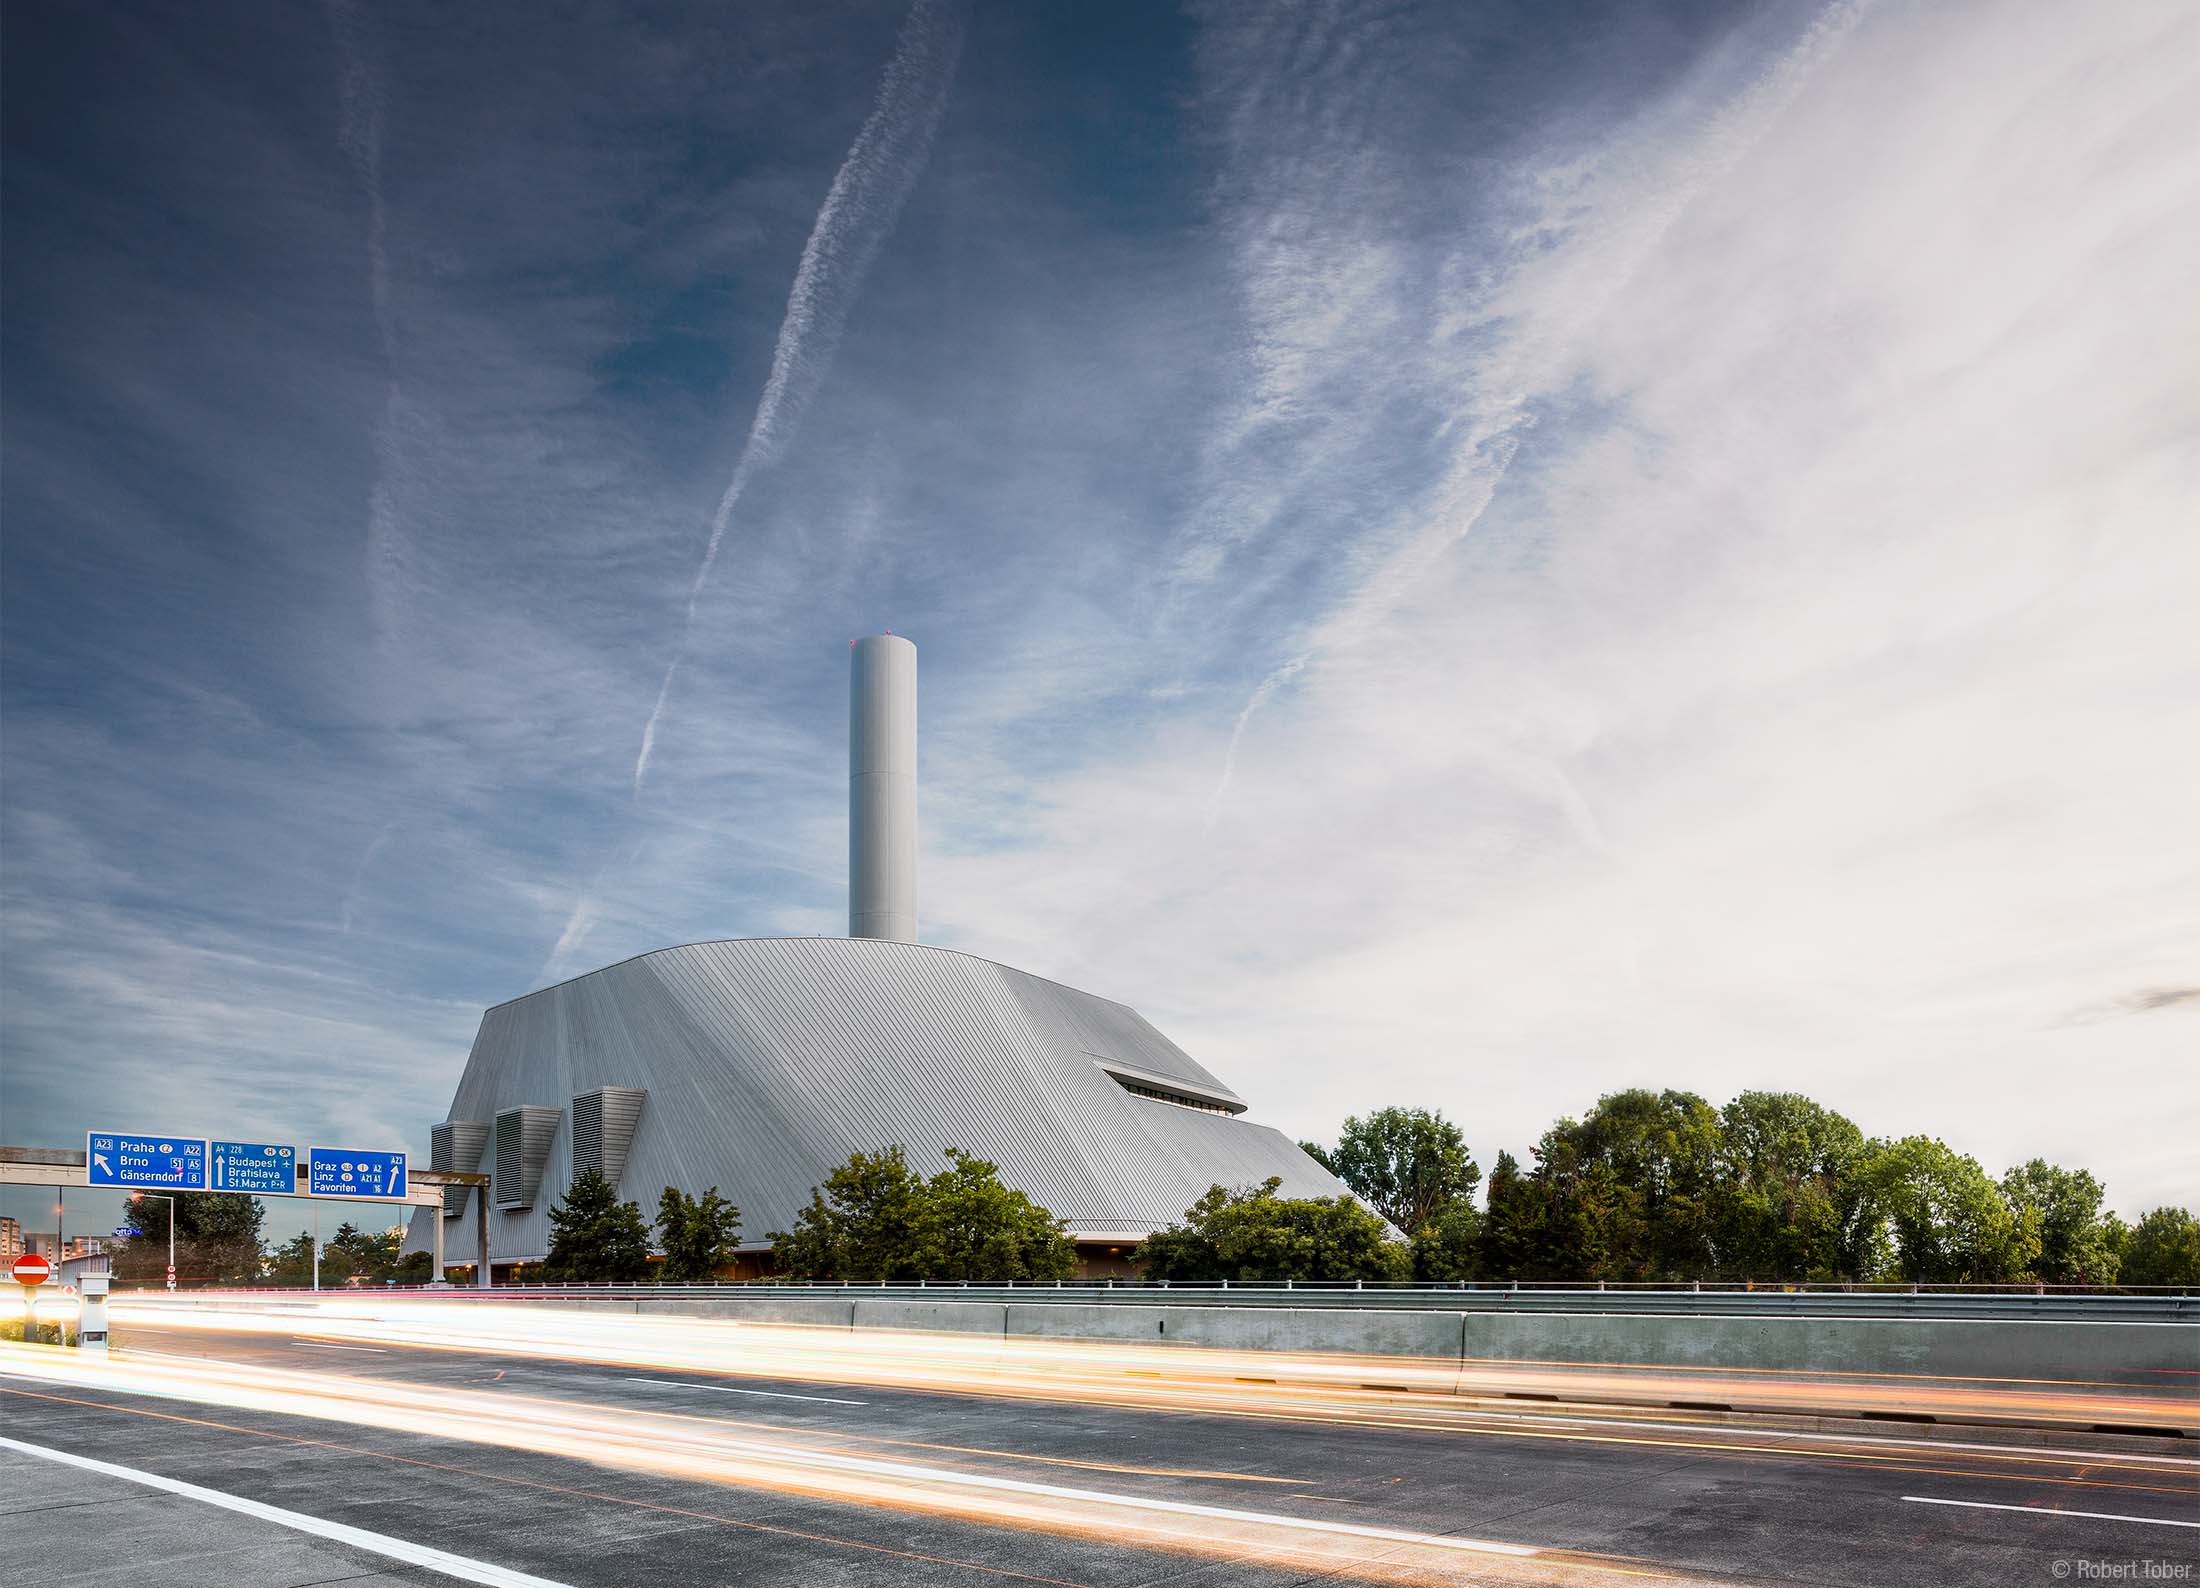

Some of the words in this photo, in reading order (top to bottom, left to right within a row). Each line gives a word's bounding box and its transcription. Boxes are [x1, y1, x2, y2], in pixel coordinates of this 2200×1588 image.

[96, 1140, 112, 1149] A23
[120, 1141, 155, 1153] Praha
[185, 1146, 200, 1155] A22
[120, 1156, 149, 1167] Brno
[172, 1159, 182, 1167] S1
[228, 1156, 277, 1168] Budapest
[391, 1156, 402, 1164] A23
[314, 1161, 337, 1171] Graz
[120, 1169, 184, 1182] Gänserndorf
[228, 1167, 280, 1178] Bratislava
[314, 1172, 334, 1181] Linz
[191, 1174, 197, 1182] 8
[314, 1182, 357, 1192] Favoriten
